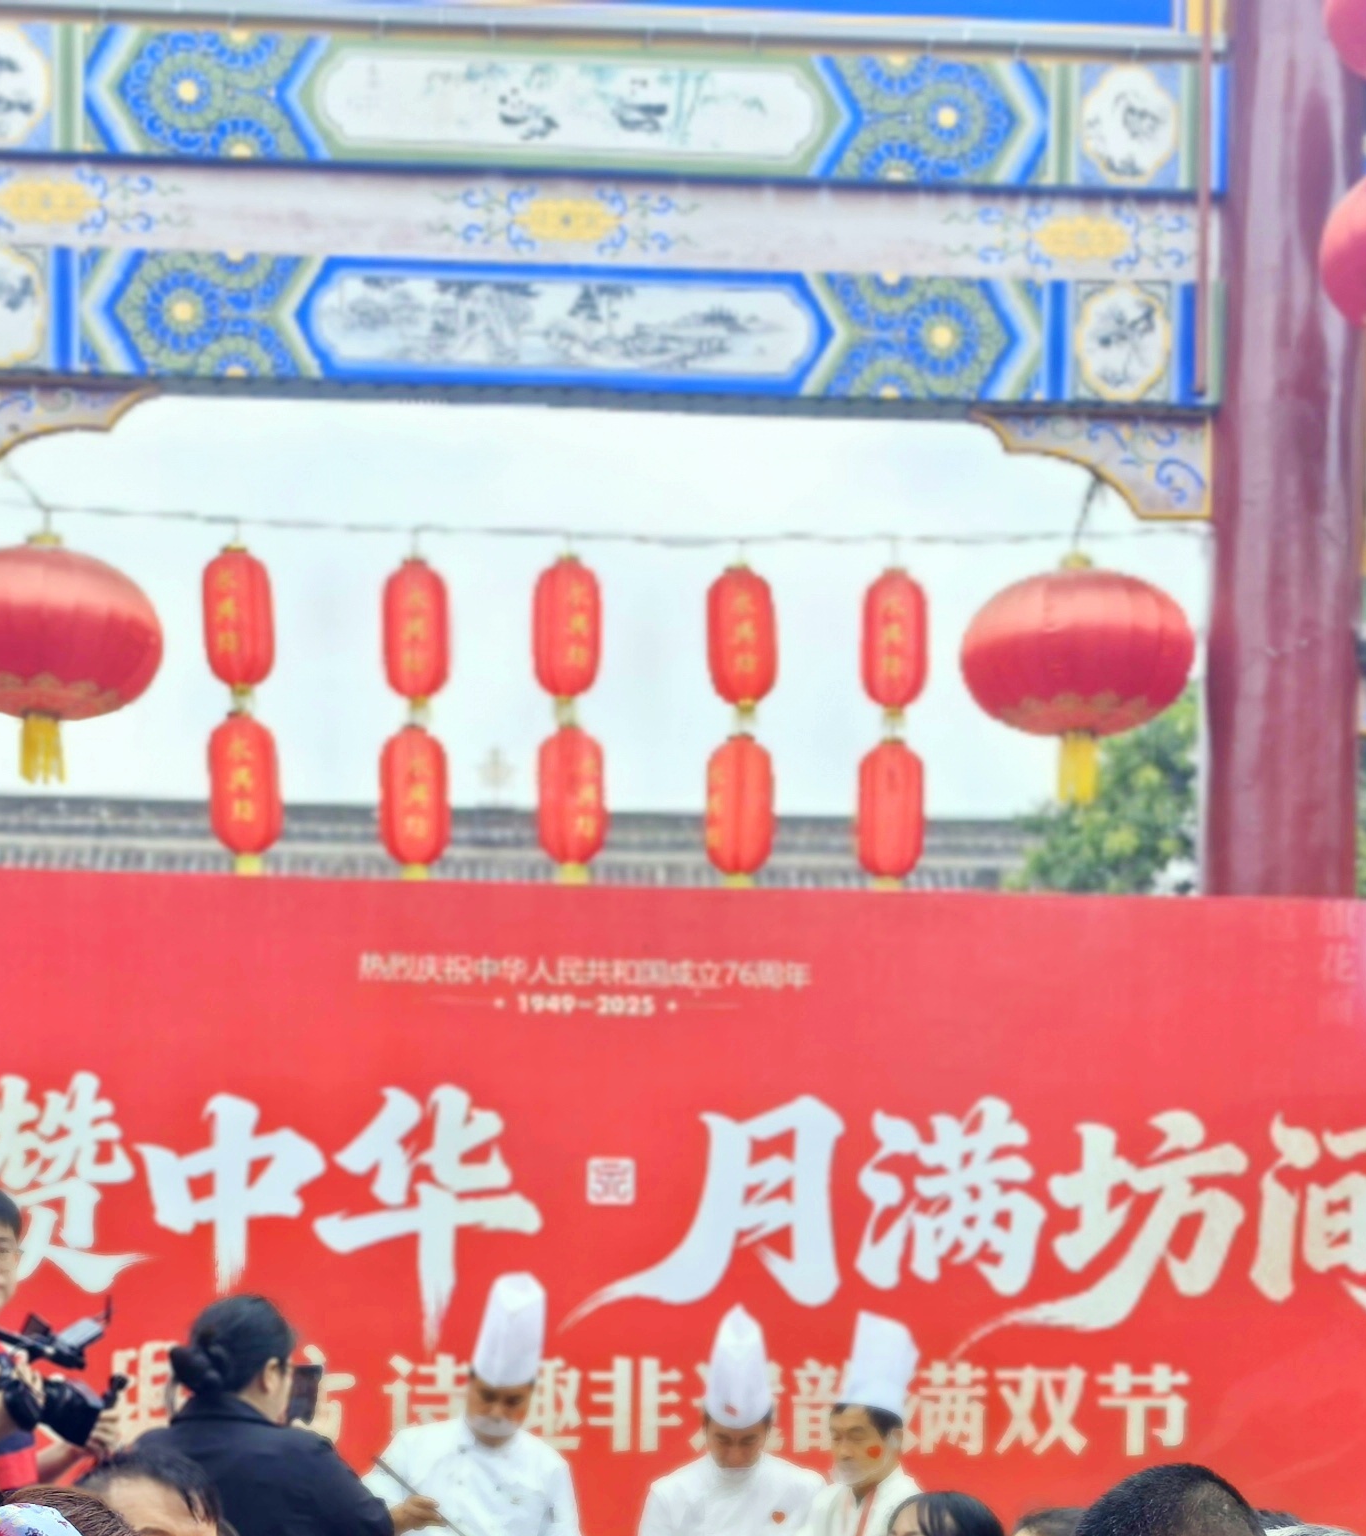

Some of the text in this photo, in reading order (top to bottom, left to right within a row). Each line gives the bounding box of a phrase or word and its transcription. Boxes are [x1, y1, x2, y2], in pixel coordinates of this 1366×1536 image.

[358, 952, 812, 990] 热烈庆祝中华人民共和国成立76周年
